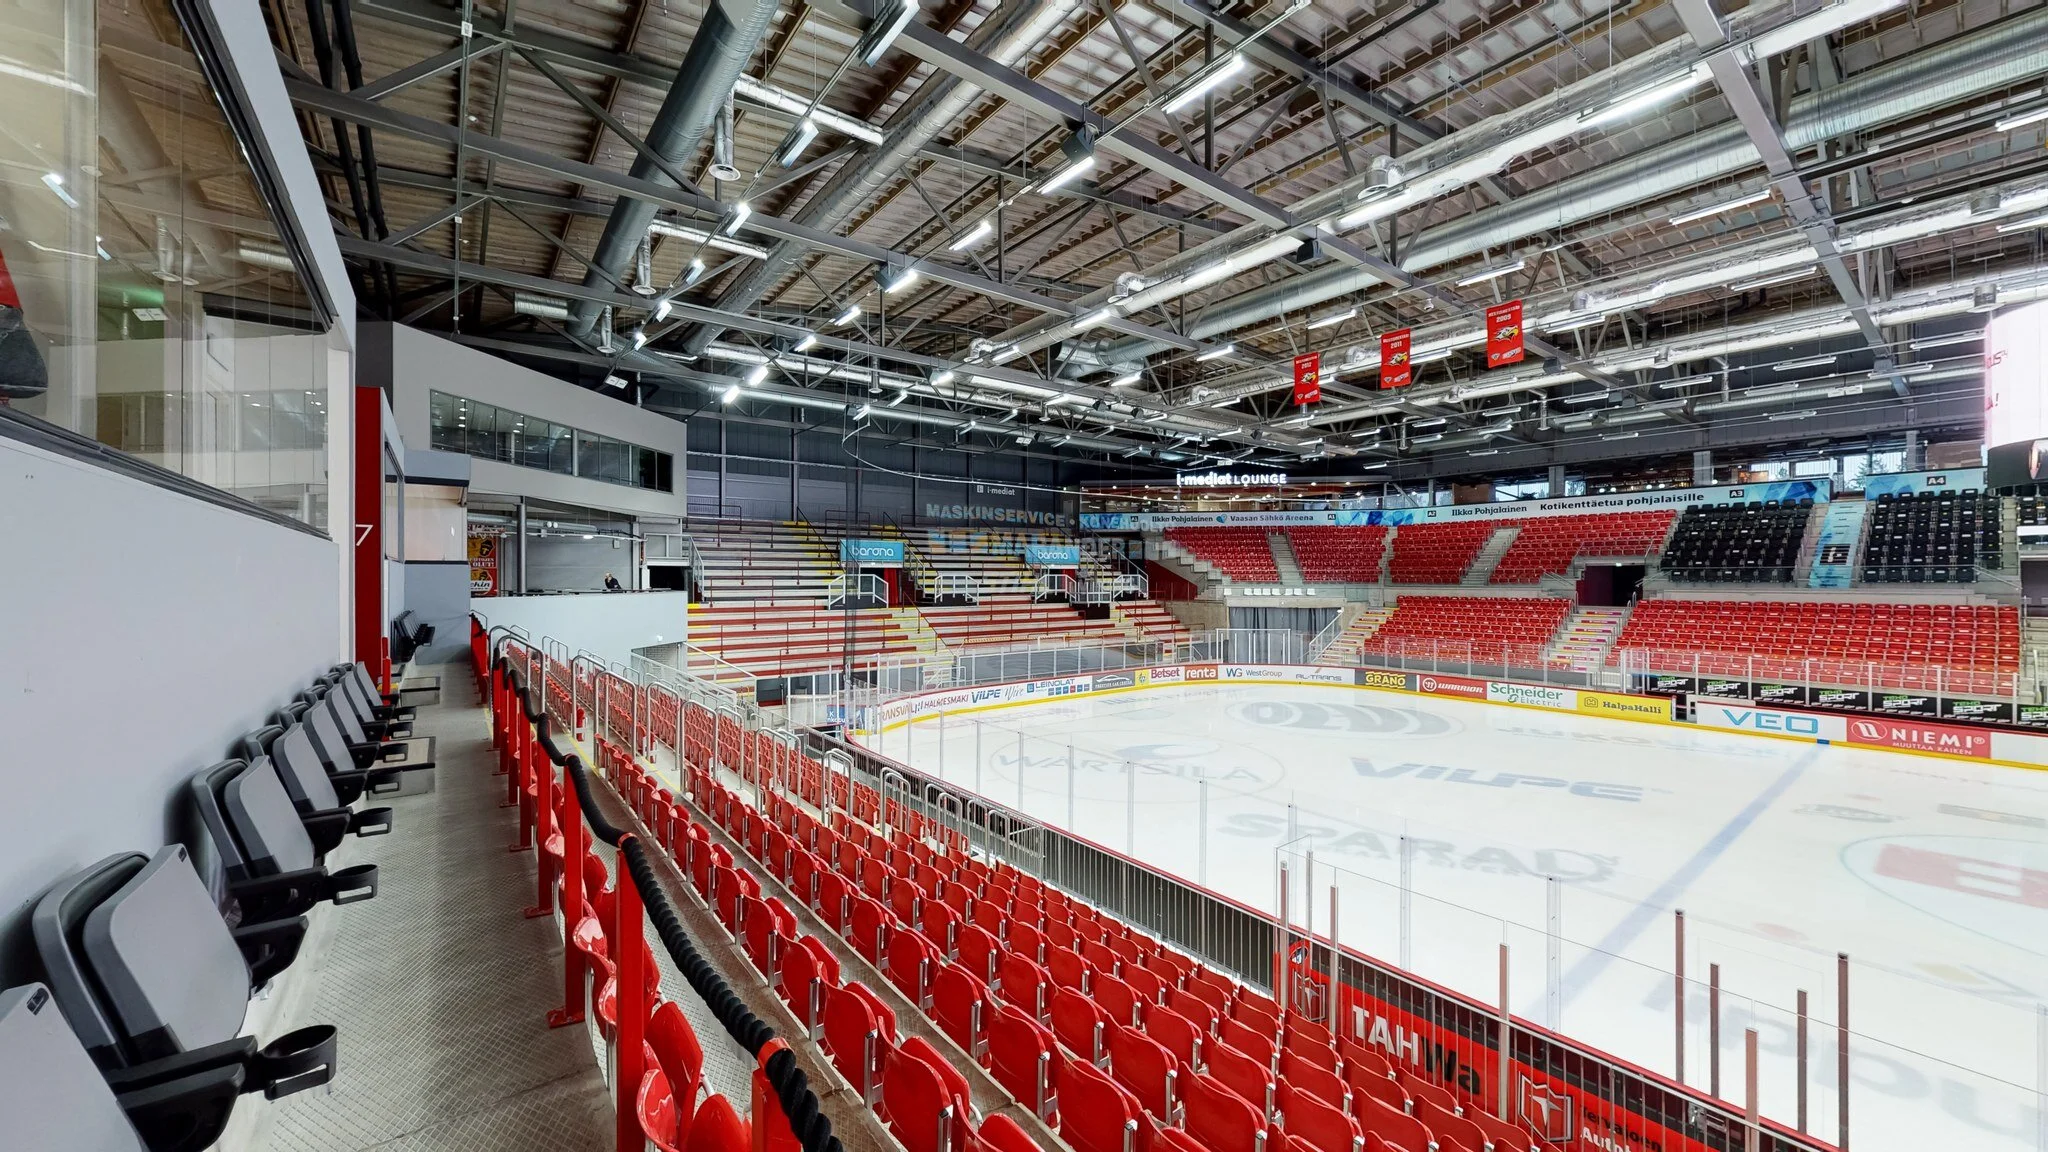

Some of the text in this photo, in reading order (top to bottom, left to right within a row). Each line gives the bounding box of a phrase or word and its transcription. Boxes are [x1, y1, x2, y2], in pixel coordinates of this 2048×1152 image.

[1234, 474, 1286, 485] LOUNGE
[1928, 477, 1945, 485] A4
[1731, 490, 1743, 498] A3
[1452, 493, 1704, 516] Ilkka Pohjalainen Kotikenttäetua pohjalaisille
[926, 503, 1065, 527] MASKINSERVICE
[1152, 515, 1170, 523] Ilkka
[1171, 515, 1213, 524] Pohjalainen
[355, 524, 373, 547] 7
[852, 545, 894, 557] barona
[1037, 550, 1069, 560] barona
[1151, 667, 1180, 679] Betset
[1185, 667, 1216, 679] renta
[1226, 668, 1283, 678] WG WestGroup
[1035, 679, 1075, 689] LEINOLAT
[1366, 673, 1406, 687] GRANO
[1657, 678, 1688, 689] SPORT
[1437, 683, 1484, 694] WARRIOR
[1490, 682, 1563, 701] Schneider
[1707, 683, 1740, 693] SPORT
[1760, 687, 1798, 697] SPORT
[1520, 697, 1561, 708] Electric
[1819, 692, 1859, 702] SPORT
[1602, 700, 1661, 714] HalpaHalli
[1883, 698, 1927, 708] SPORT
[1953, 704, 2002, 715] SPORT
[1722, 708, 1819, 734] VEO
[1892, 742, 1973, 756] MUUTTAA KAIKEN
